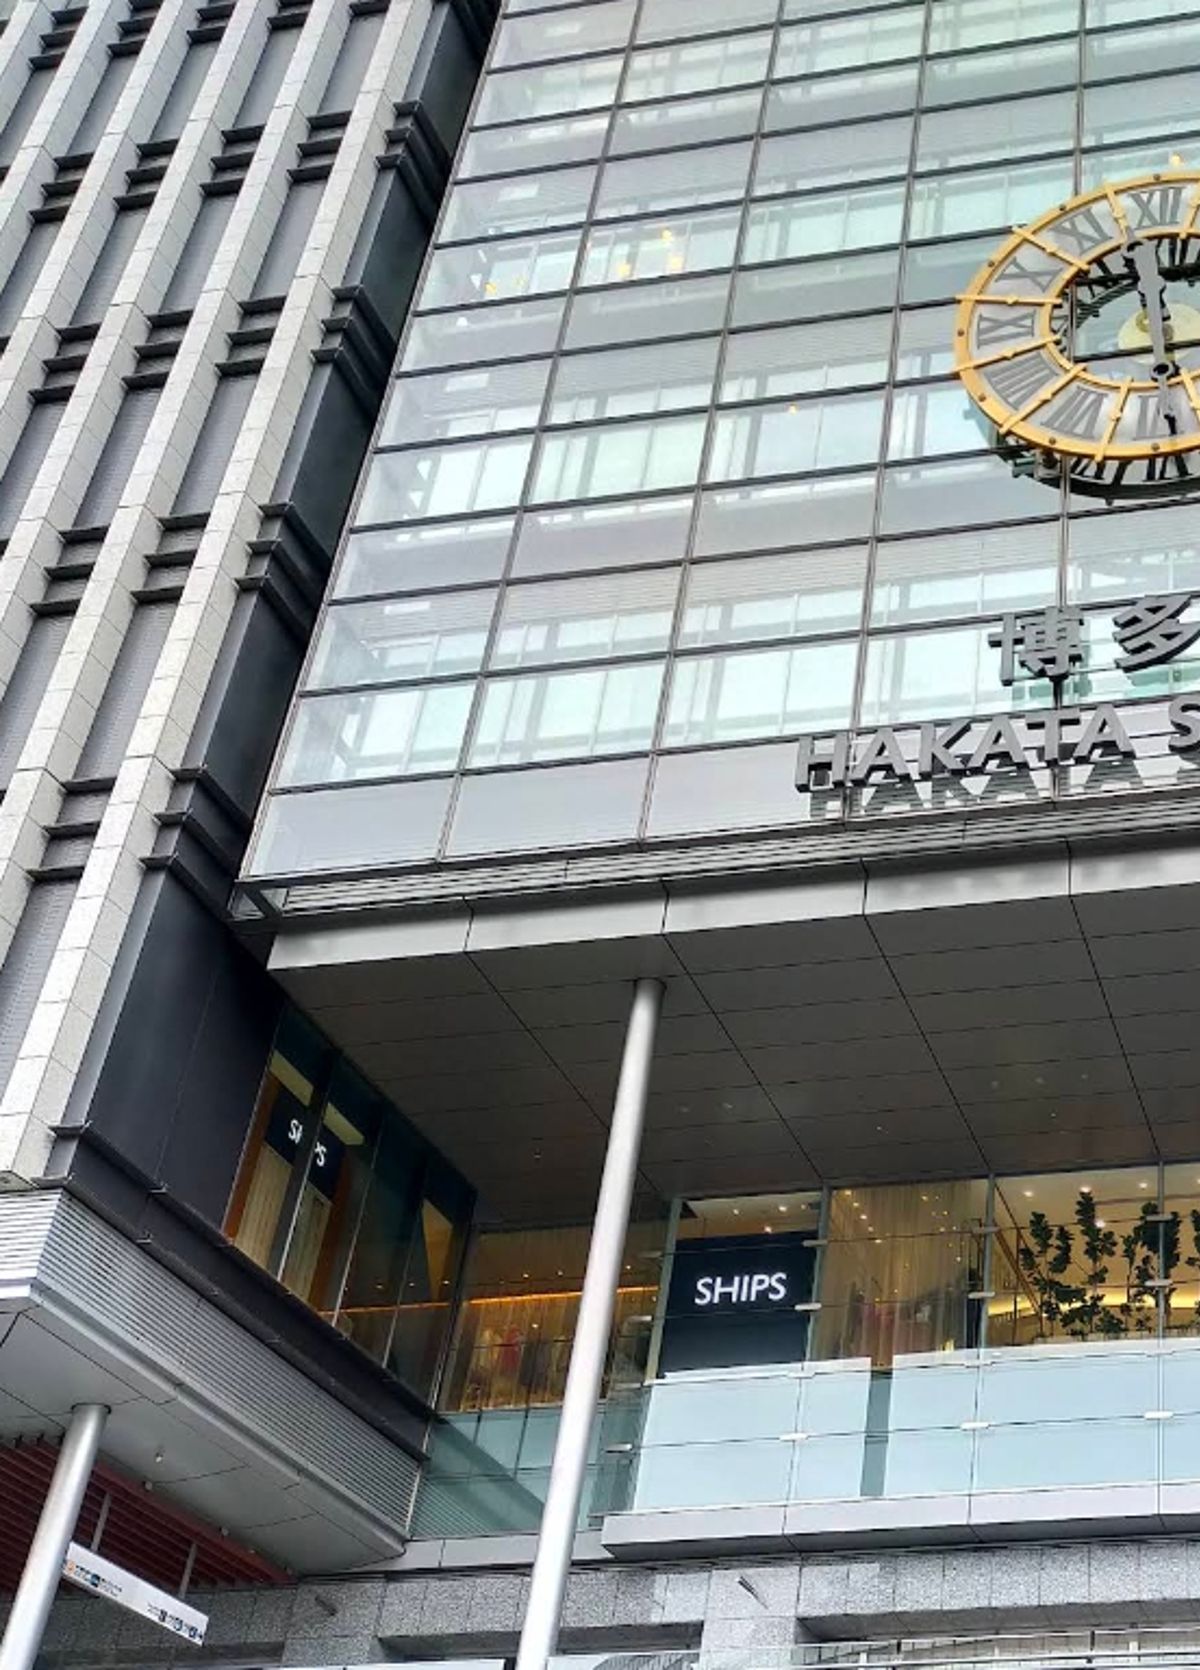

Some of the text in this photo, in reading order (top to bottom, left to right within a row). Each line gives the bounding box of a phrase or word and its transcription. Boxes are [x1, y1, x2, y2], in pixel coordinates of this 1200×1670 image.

[1048, 206, 1114, 254] XI
[1128, 186, 1185, 230] XII
[995, 256, 1063, 293] X
[977, 309, 1036, 349] IX
[983, 351, 1059, 410] VIII
[1040, 385, 1109, 440] VII
[795, 703, 1136, 792] HAKATA
[694, 1272, 787, 1306] SHIPS
